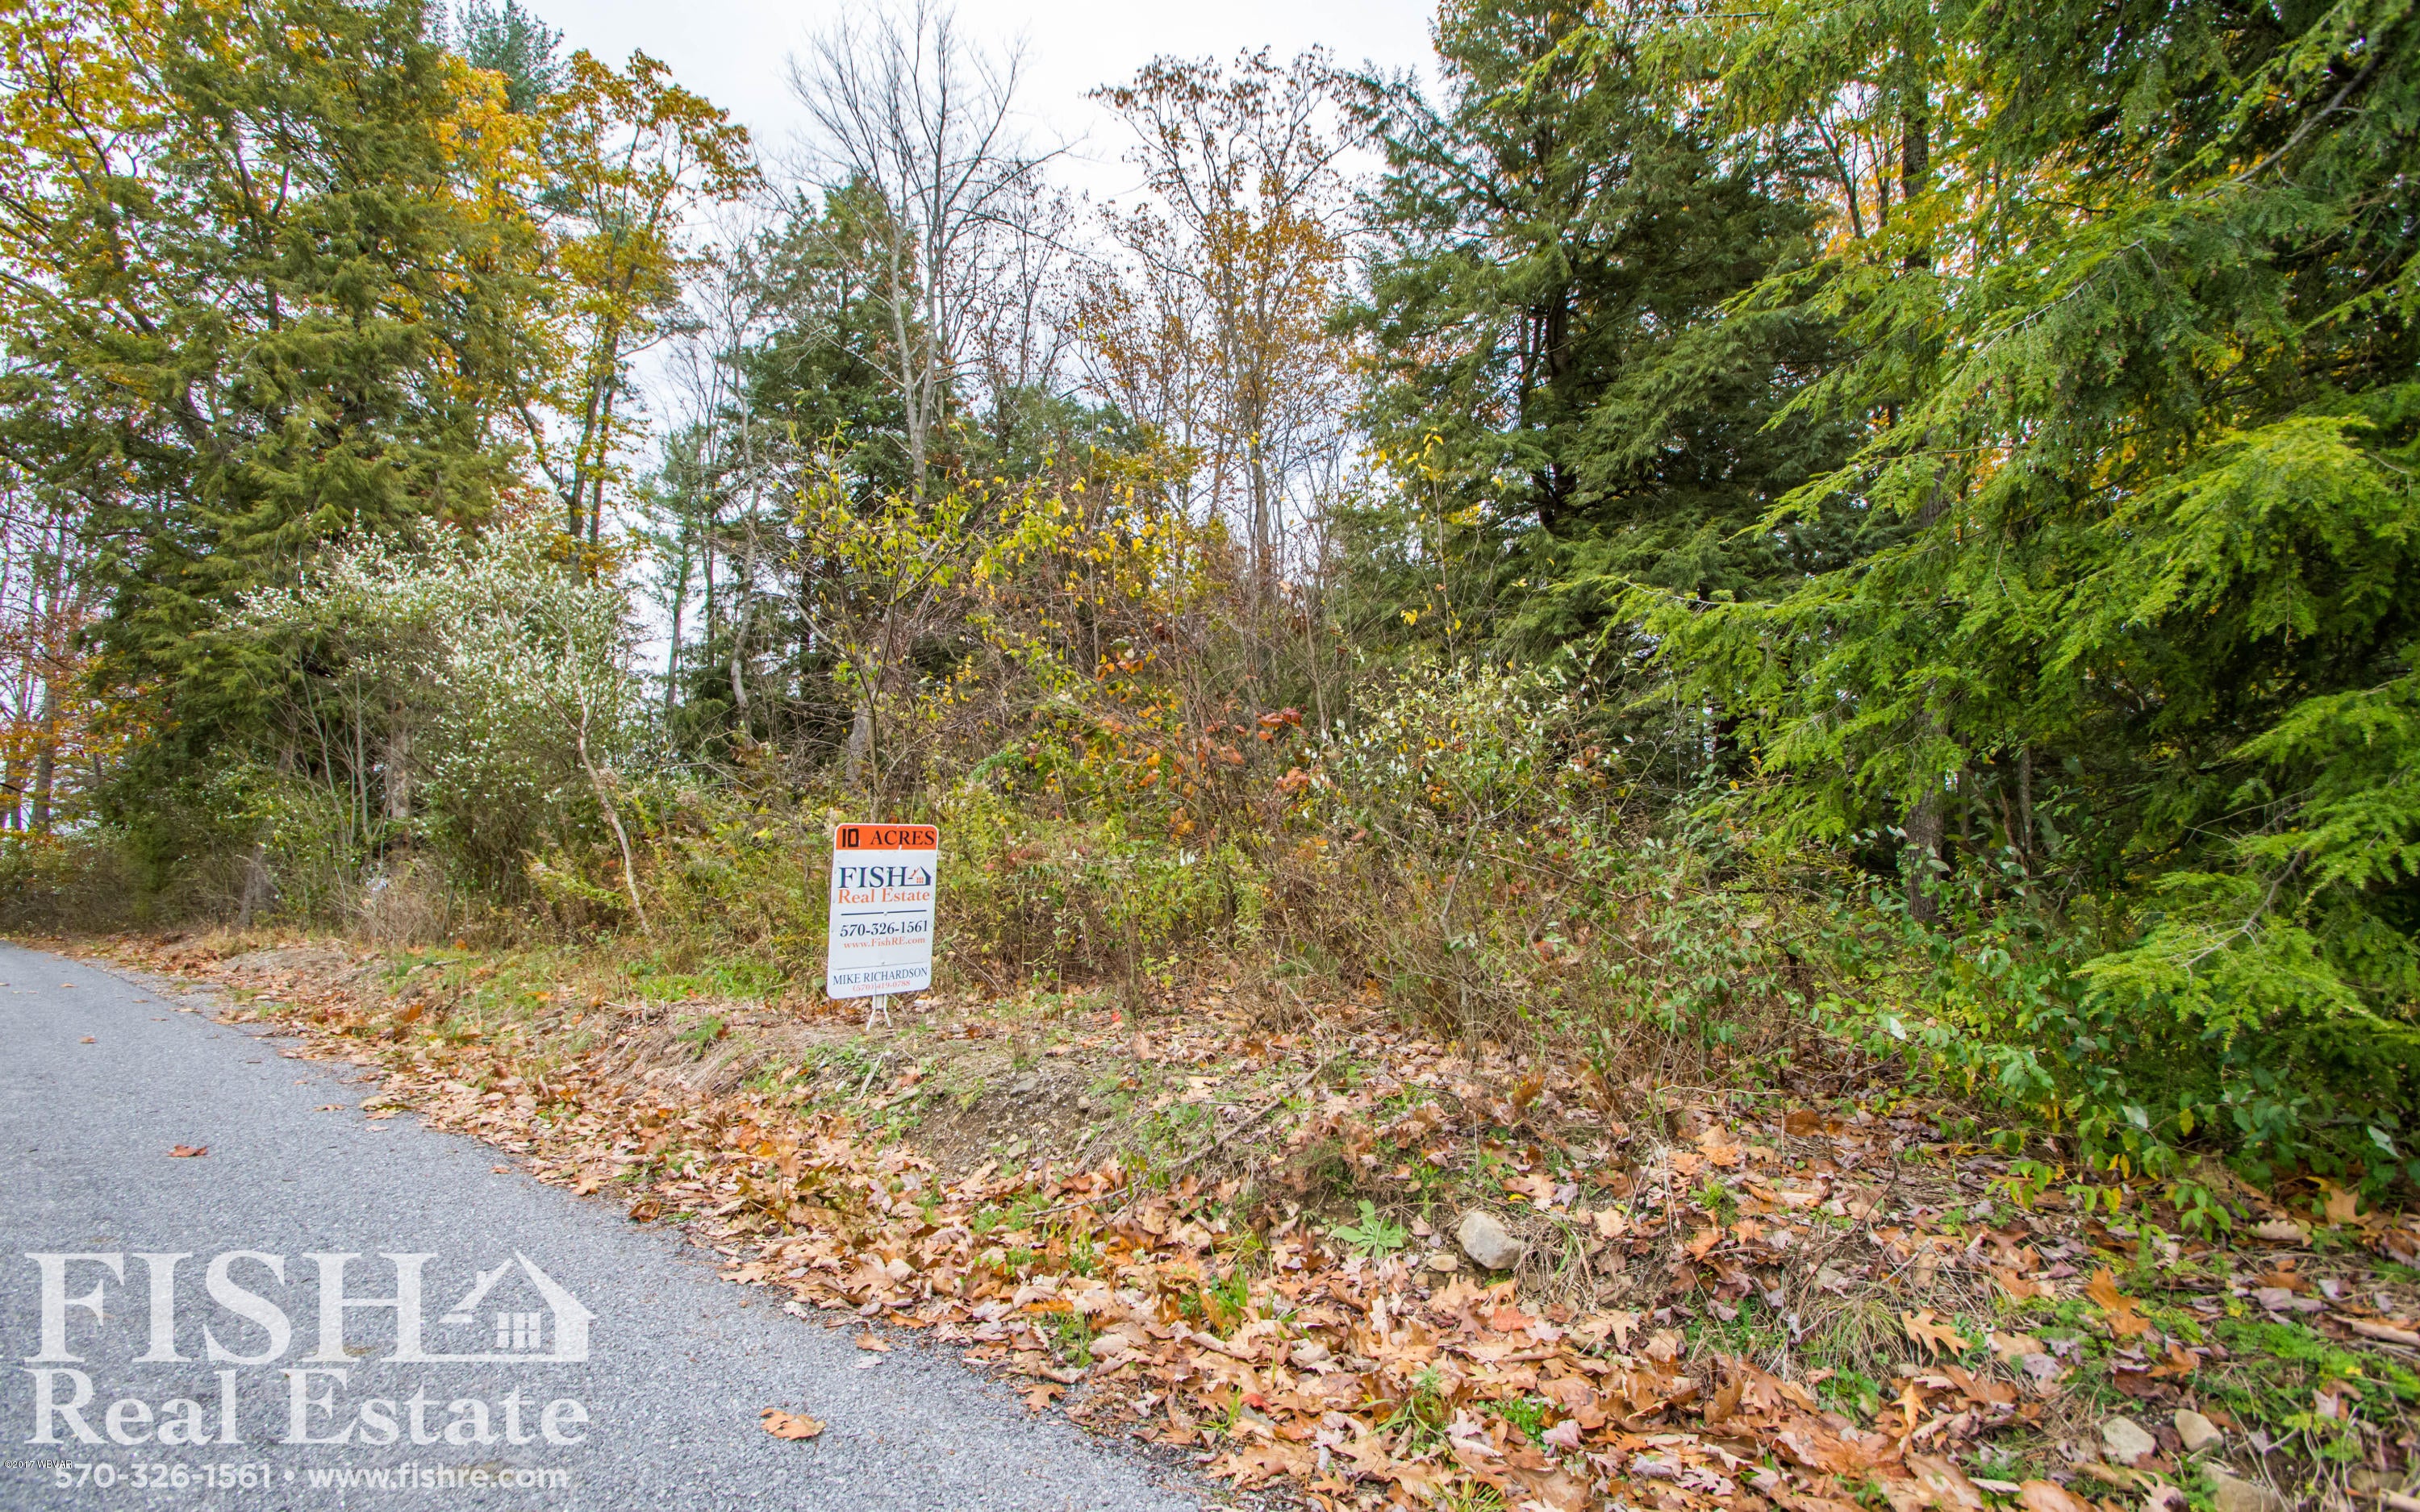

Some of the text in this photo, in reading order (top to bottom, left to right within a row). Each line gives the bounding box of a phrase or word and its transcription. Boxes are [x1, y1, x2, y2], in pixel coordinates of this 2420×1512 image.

[841, 828, 935, 848] 10 ACRES
[838, 866, 908, 888] FISH
[838, 887, 930, 904] Real Estate
[840, 920, 928, 937] 570-326-1561
[844, 936, 925, 949] www.FishRE.com
[832, 967, 928, 985] MIKE RICHARDSON
